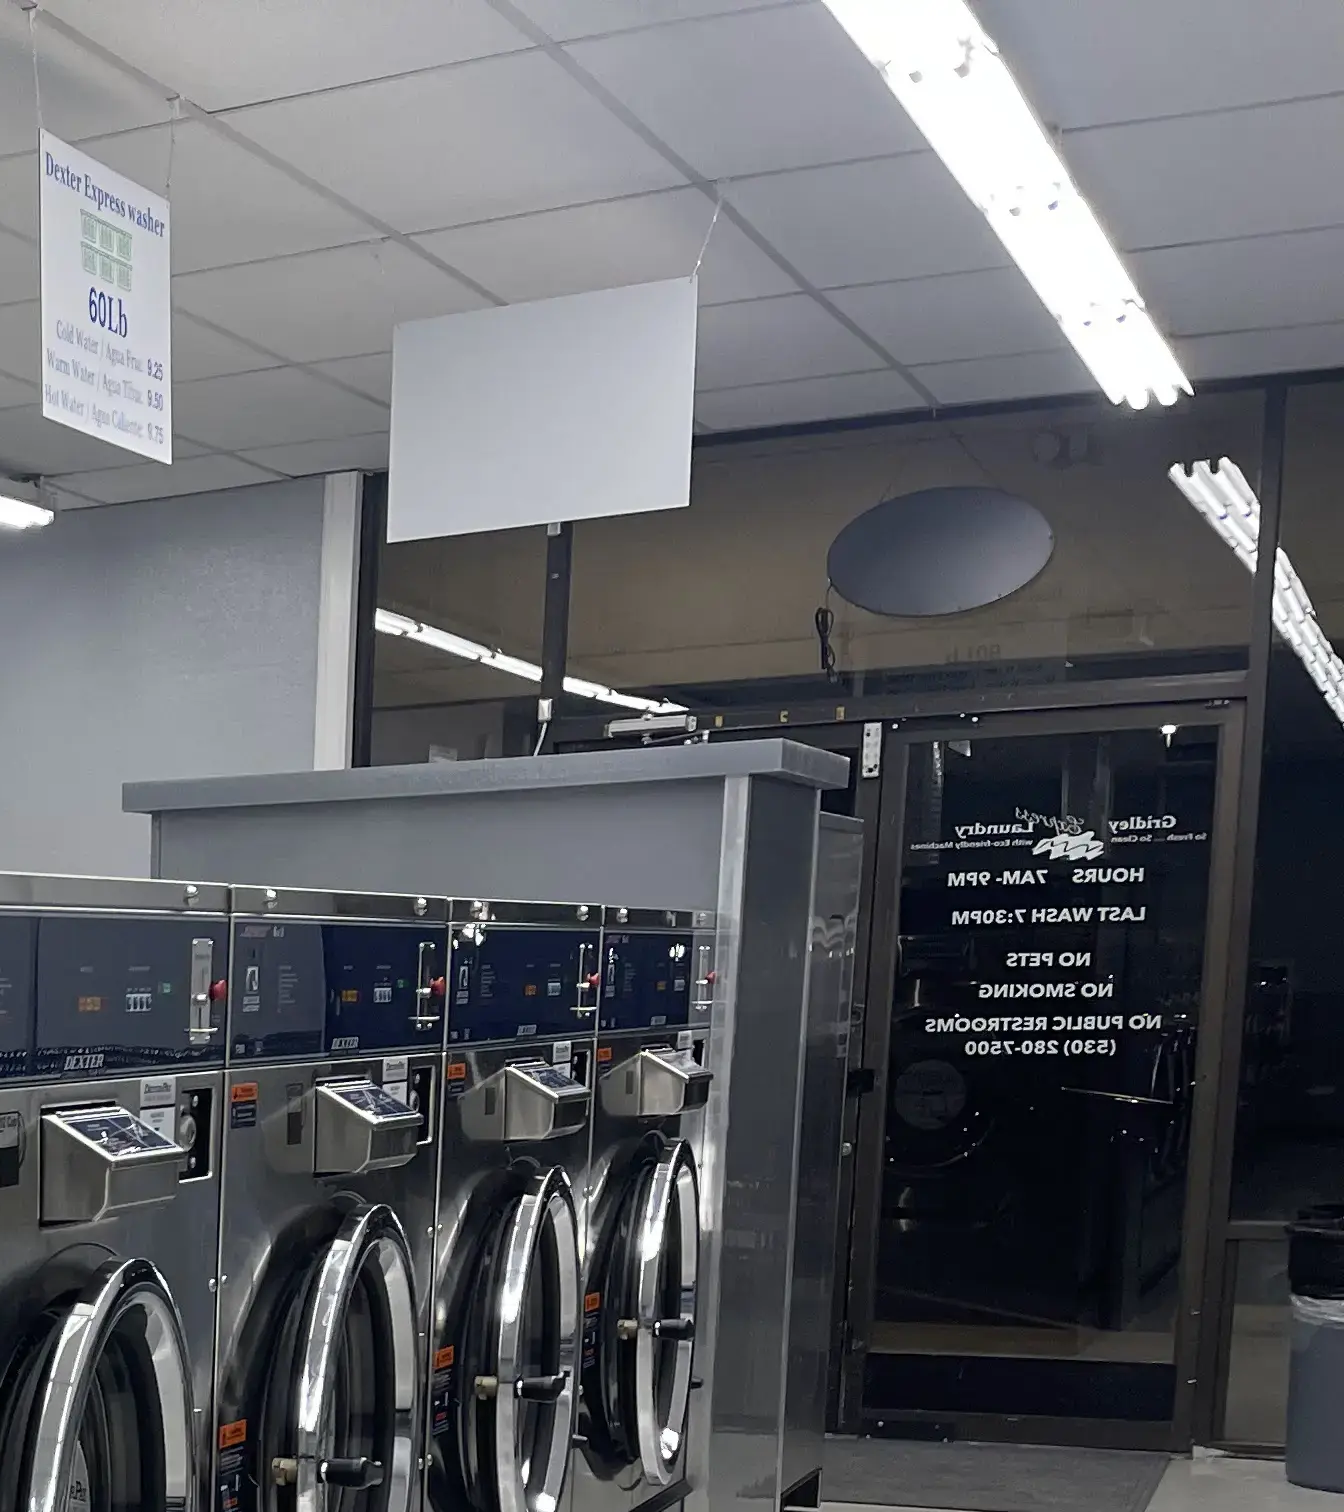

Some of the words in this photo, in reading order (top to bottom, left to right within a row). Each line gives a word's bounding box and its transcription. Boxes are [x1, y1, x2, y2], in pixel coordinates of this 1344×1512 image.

[46, 152, 82, 192] Dexter
[84, 173, 125, 217] Express
[128, 205, 165, 238] washer
[88, 287, 128, 338] 60Lb
[75, 327, 98, 354] Water
[64, 1054, 104, 1071] DEXTER
